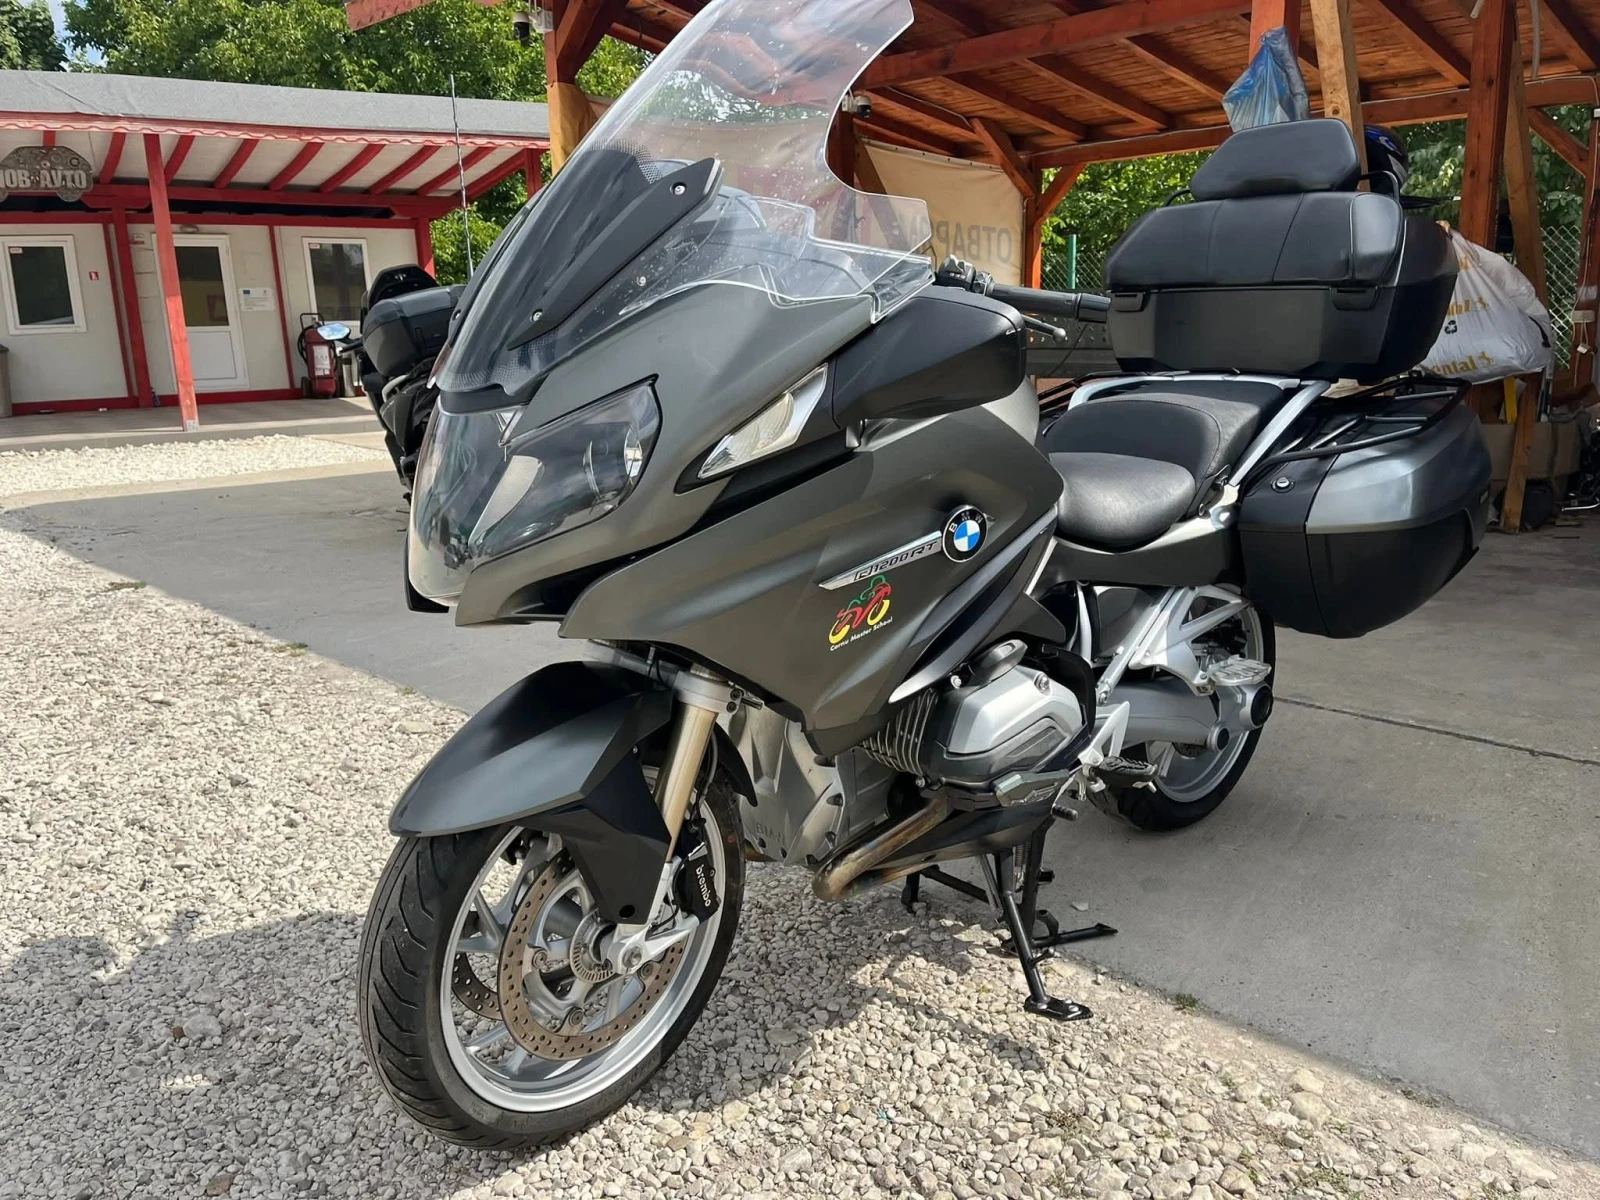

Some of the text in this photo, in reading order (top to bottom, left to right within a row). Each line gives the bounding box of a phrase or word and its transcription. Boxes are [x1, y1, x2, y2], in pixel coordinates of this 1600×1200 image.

[949, 512, 983, 533] BMW
[850, 627, 872, 642] Master
[873, 615, 893, 631] School
[695, 864, 712, 907] brembo
